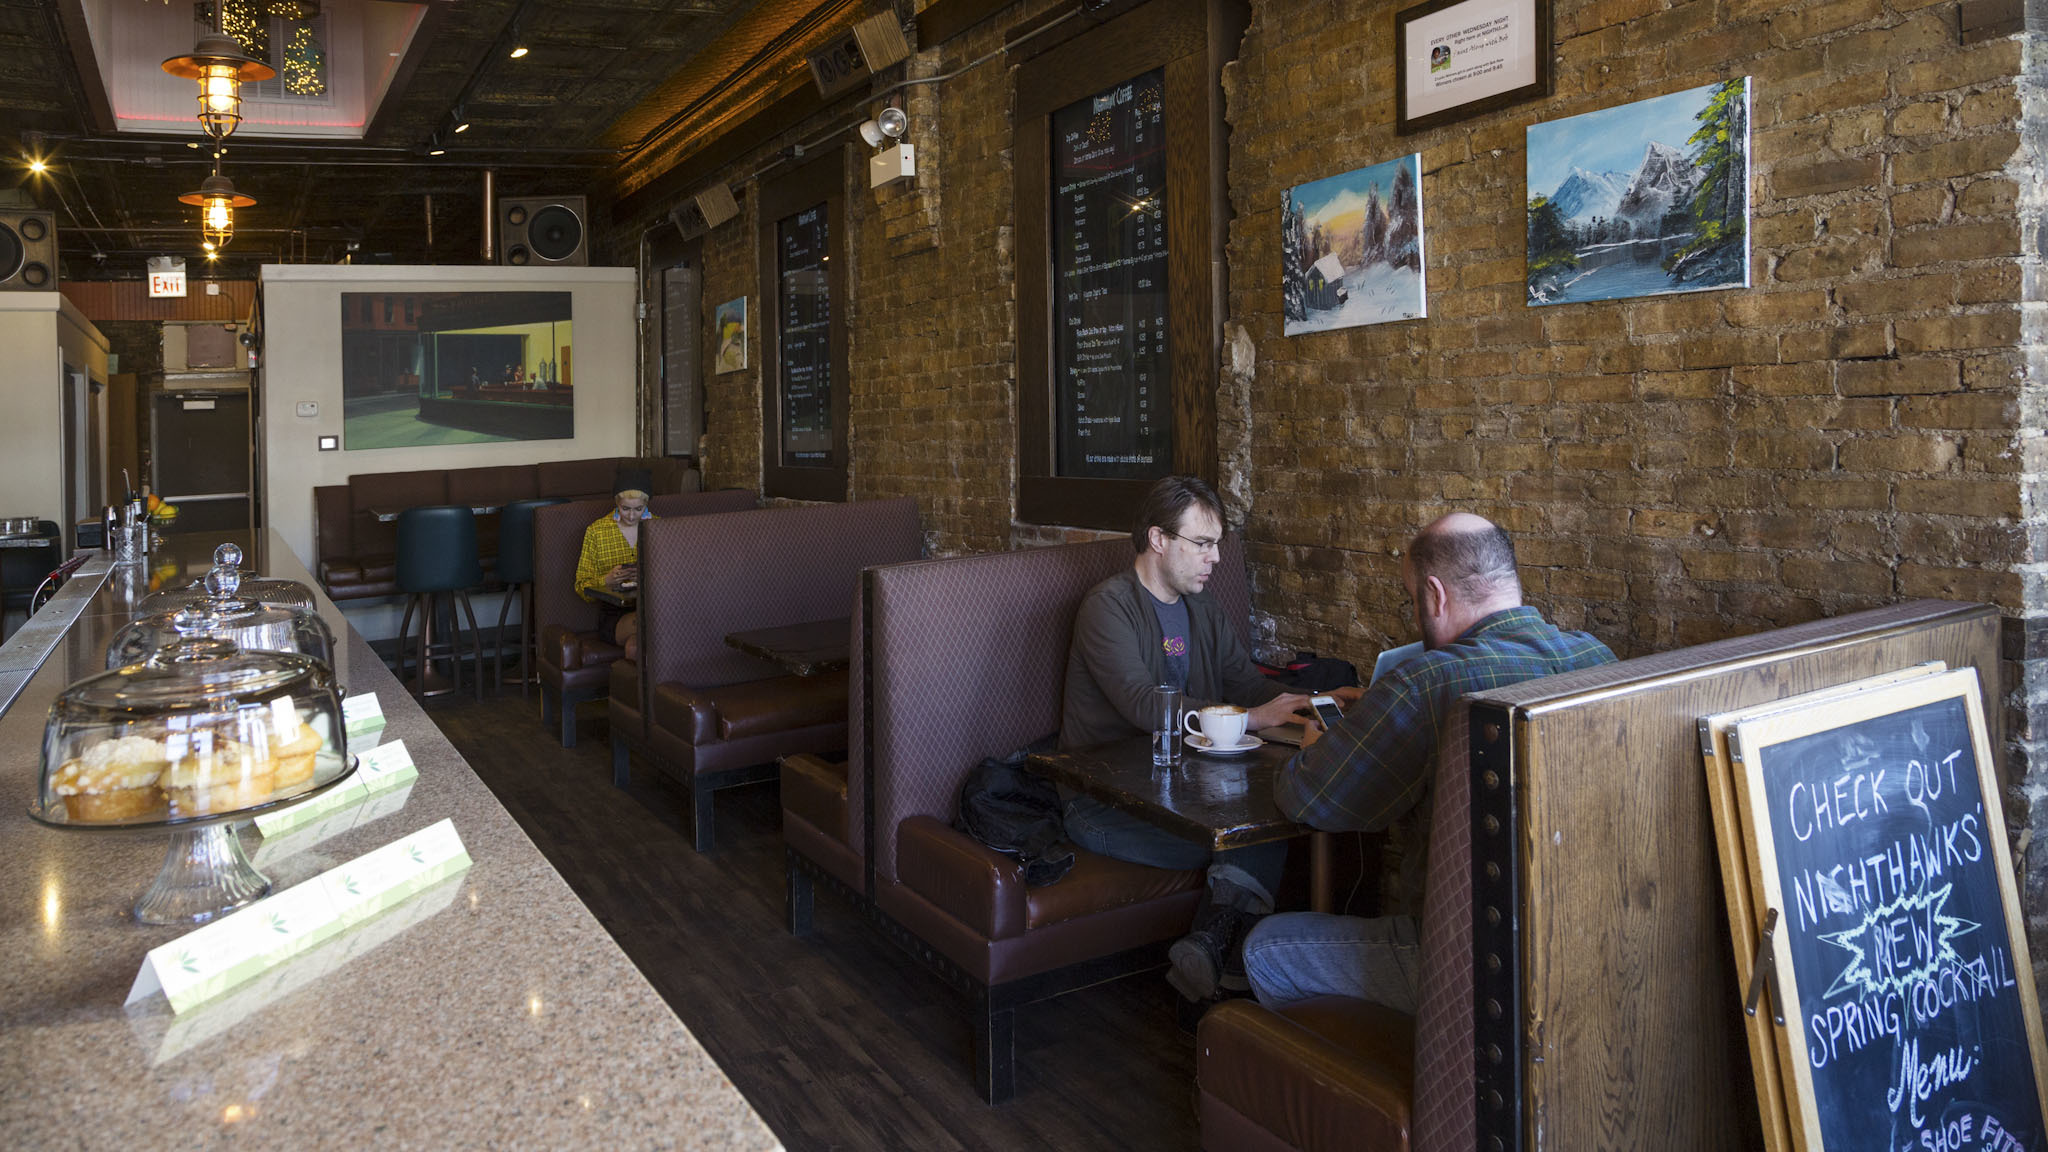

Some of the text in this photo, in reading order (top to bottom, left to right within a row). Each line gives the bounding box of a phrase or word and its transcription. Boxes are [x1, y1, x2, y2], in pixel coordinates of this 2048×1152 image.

[1430, 15, 1509, 46] EVERY OTHER WEDNESDAY NIGHT
[1454, 37, 1466, 45] Right
[1789, 749, 1962, 842] CHECK OUT
[1873, 914, 1935, 982] NEW
[1810, 944, 2016, 1069] SPRING COCKTAIL
[1886, 1036, 1980, 1129] Menu:
[1920, 1113, 1973, 1152] SHOE
